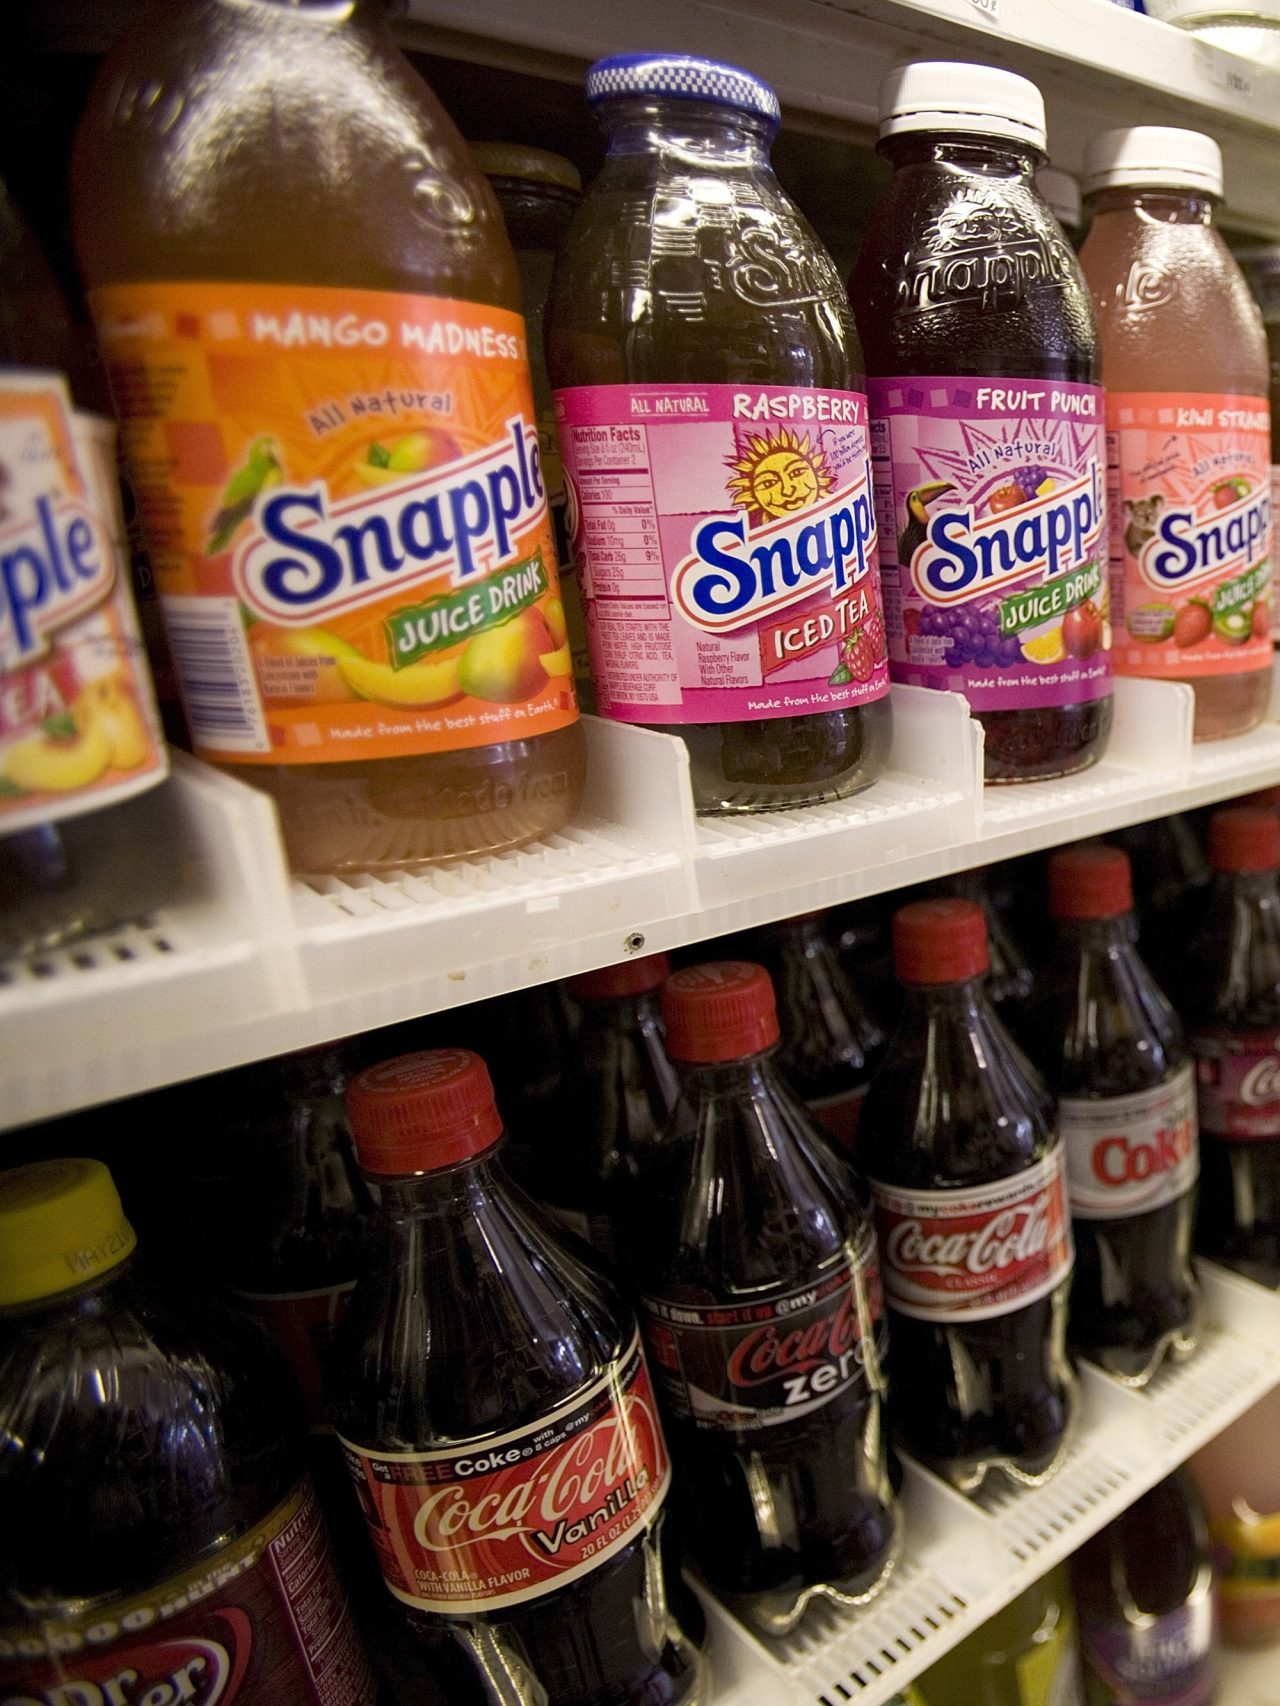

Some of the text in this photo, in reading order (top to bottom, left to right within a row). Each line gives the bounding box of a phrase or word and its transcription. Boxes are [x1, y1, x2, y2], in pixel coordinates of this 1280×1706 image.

[252, 312, 518, 359] MANGO MADNESS
[631, 397, 710, 414] ALL NATURAL
[733, 392, 860, 424] RASPBERRY
[976, 388, 1096, 416] FRUIT PUNCH
[309, 390, 451, 436] All Natural
[572, 426, 641, 443] Nutrition Facts
[632, 454, 636, 465] 2
[968, 441, 1056, 473] All Natural
[619, 506, 632, 515] Daily
[641, 518, 656, 530] 0%
[927, 461, 1103, 592] Snappl
[643, 534, 658, 546] 0%
[692, 460, 875, 616] Snappl
[645, 550, 660, 561] 9%
[398, 560, 543, 653] JUICE DRINK
[1006, 567, 1100, 628] JUICE DRINK
[659, 622, 670, 631] THE
[774, 589, 869, 659] ICED TEA
[655, 632, 671, 641] MADE
[644, 642, 672, 651] FRUCTOSE
[696, 642, 720, 651] Natural
[698, 652, 750, 664] Raspberry Flavor
[671, 673, 678, 681] OF
[699, 664, 734, 674] With Other
[701, 675, 749, 685] Natural Flavors
[998, 676, 1019, 687] from
[1021, 675, 1038, 686] the
[1039, 673, 1058, 685] best
[748, 699, 781, 710] Made
[784, 695, 809, 707] from
[811, 692, 829, 703] the
[831, 690, 850, 702] best
[378, 723, 411, 736] from
[415, 717, 442, 732] the
[445, 714, 477, 729] best
[479, 706, 512, 725] stuff
[533, 1430, 555, 1444] with
[535, 1431, 567, 1451] 8 caps
[391, 1464, 453, 1481] FREE
[454, 1449, 520, 1477] Coke
[414, 1417, 637, 1551] Coca-Cola
[536, 1463, 650, 1555] Vanilla
[581, 1526, 623, 1560] 20 FL OZ
[414, 1569, 470, 1583] COCA-COLA
[417, 1567, 532, 1593] WITH VANILLA FLAVOR
